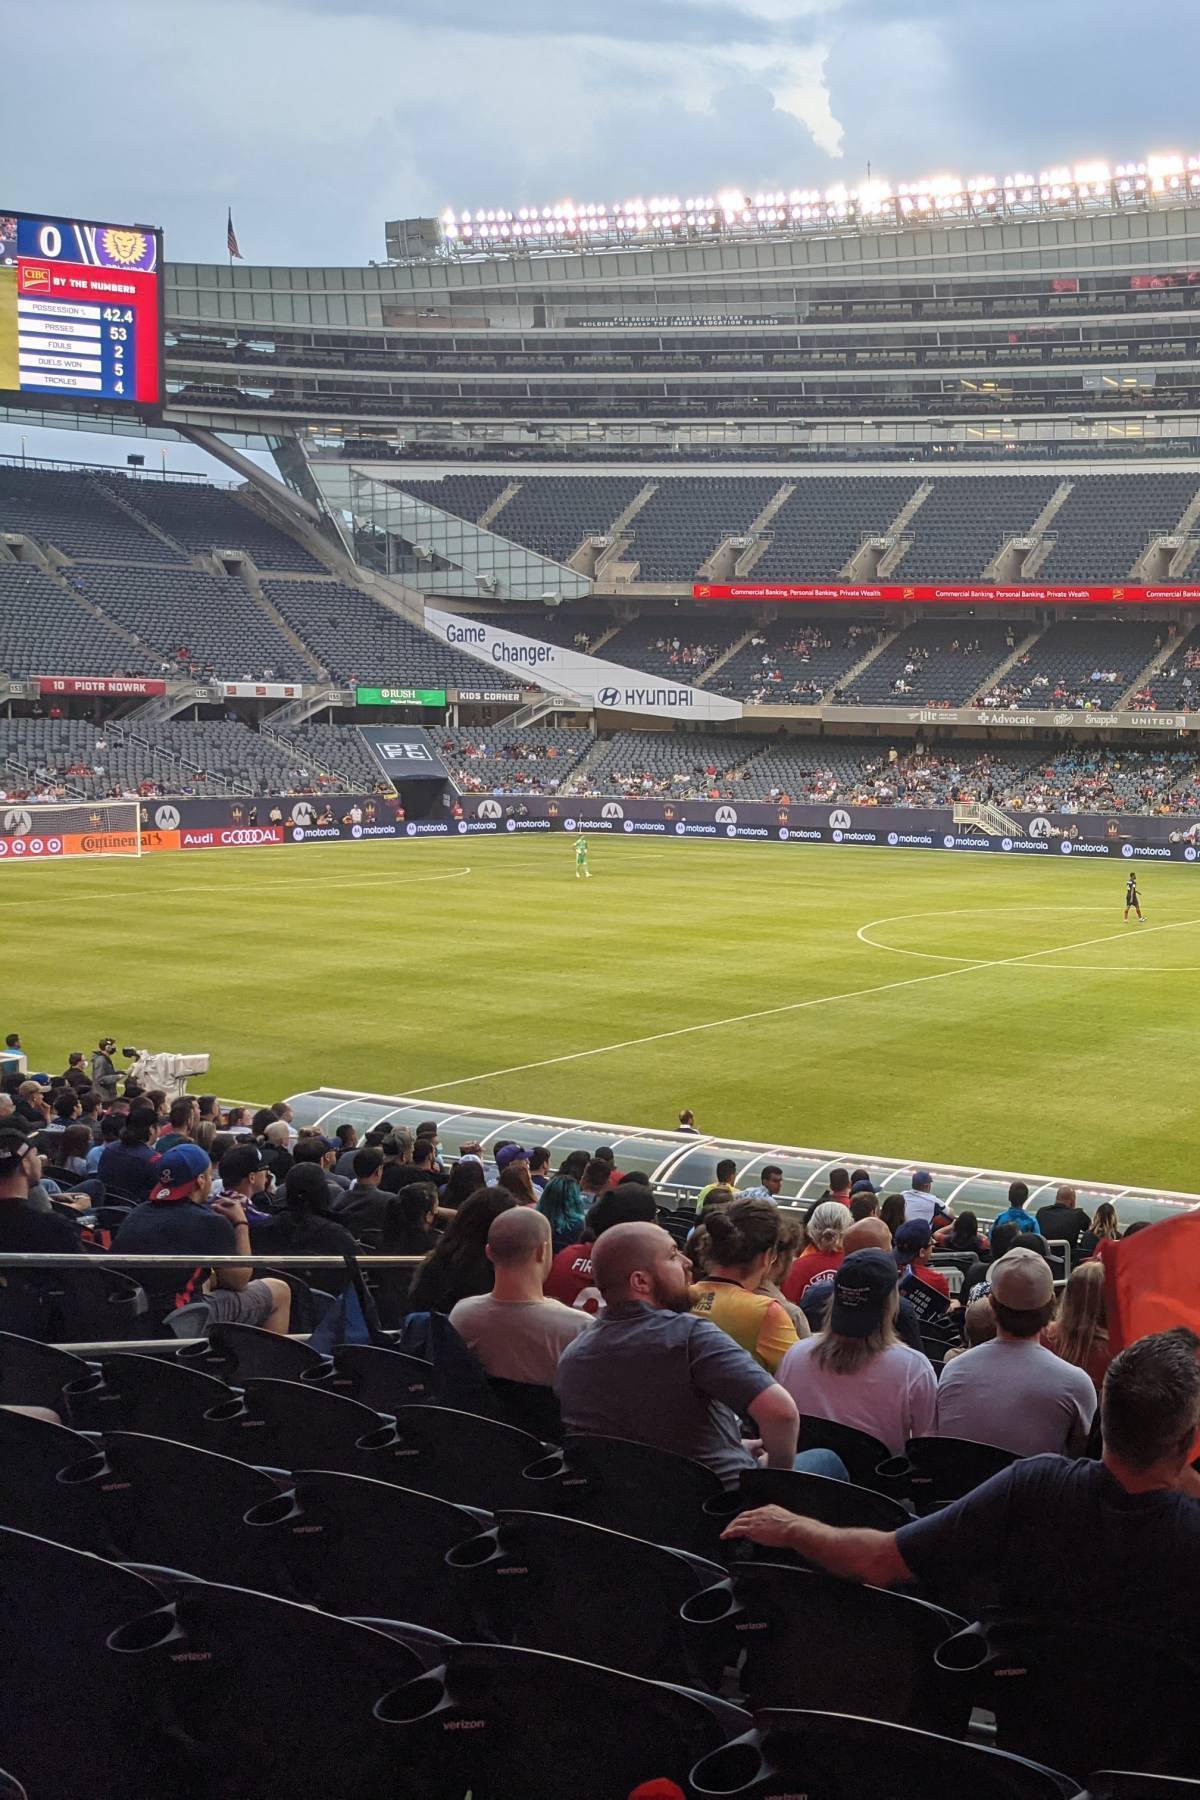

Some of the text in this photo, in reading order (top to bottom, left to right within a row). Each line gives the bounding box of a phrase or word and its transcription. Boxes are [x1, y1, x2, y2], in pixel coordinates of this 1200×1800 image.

[40, 226, 62, 258] 0
[25, 270, 49, 281] CIBC
[54, 278, 136, 295] BY THE NUMBERS
[32, 304, 79, 316] POSSESSION
[104, 308, 133, 325] 42.4
[45, 323, 74, 334] PASSES
[110, 328, 127, 341] 53
[48, 341, 72, 351] FOULS
[115, 346, 124, 359] 2
[38, 358, 82, 372] DUELS WON
[115, 364, 124, 377] 5
[44, 376, 77, 388] TACKLES
[114, 381, 125, 395] 4
[731, 588, 764, 596] Commercial
[860, 589, 881, 597] Wealth
[1147, 590, 1181, 598] Commercial
[446, 624, 485, 643] Game
[492, 642, 555, 666] Changer.
[54, 681, 146, 692] 10 PIOTR NOWAK
[391, 689, 416, 699] RUSH
[460, 692, 520, 701] KIDS CORNER
[626, 690, 693, 706] HYUNDAI
[991, 713, 1036, 725] Advocate
[1085, 714, 1118, 727] Snapple
[361, 825, 396, 835] motorola
[417, 823, 448, 832] motorola
[468, 821, 497, 830] motorola
[515, 820, 551, 829] motorola
[577, 820, 612, 829] motorola
[632, 823, 665, 831] motorola
[684, 824, 717, 833] motorola
[304, 828, 340, 837] motorola
[736, 827, 769, 836] motorola
[789, 830, 822, 839] motorola
[842, 832, 876, 841] motorola
[81, 834, 151, 852] Continenal
[184, 833, 214, 844] Audi
[897, 835, 932, 844] motorola
[955, 838, 990, 847] motorola
[1013, 841, 1049, 850] motorola
[1071, 843, 1109, 852] motorola
[1134, 847, 1171, 856] motorola
[571, 1257, 593, 1274] FIR
[735, 1621, 768, 1631] verizon
[172, 1651, 211, 1662] verizon
[443, 1719, 485, 1730] verizon
